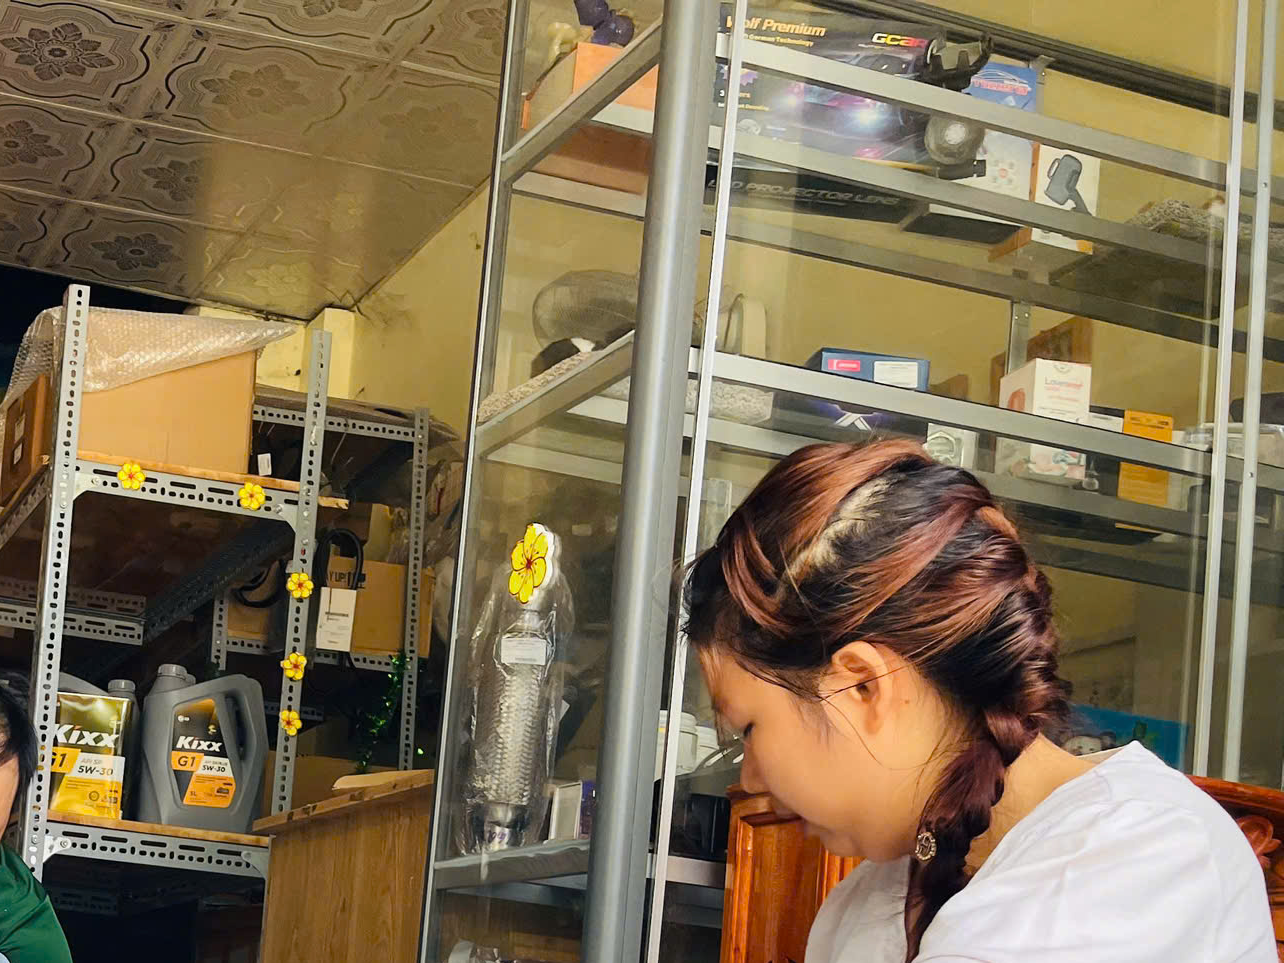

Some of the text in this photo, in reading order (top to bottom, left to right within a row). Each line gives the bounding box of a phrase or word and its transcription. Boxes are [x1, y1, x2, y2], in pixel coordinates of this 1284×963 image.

[762, 18, 826, 36] Premium
[746, 182, 853, 202] PROJECTOR
[55, 723, 119, 748] Kixx
[176, 735, 223, 752] Kixx
[177, 755, 197, 768] G1
[202, 764, 227, 774] 5W-30
[77, 765, 114, 777] 5W-30
